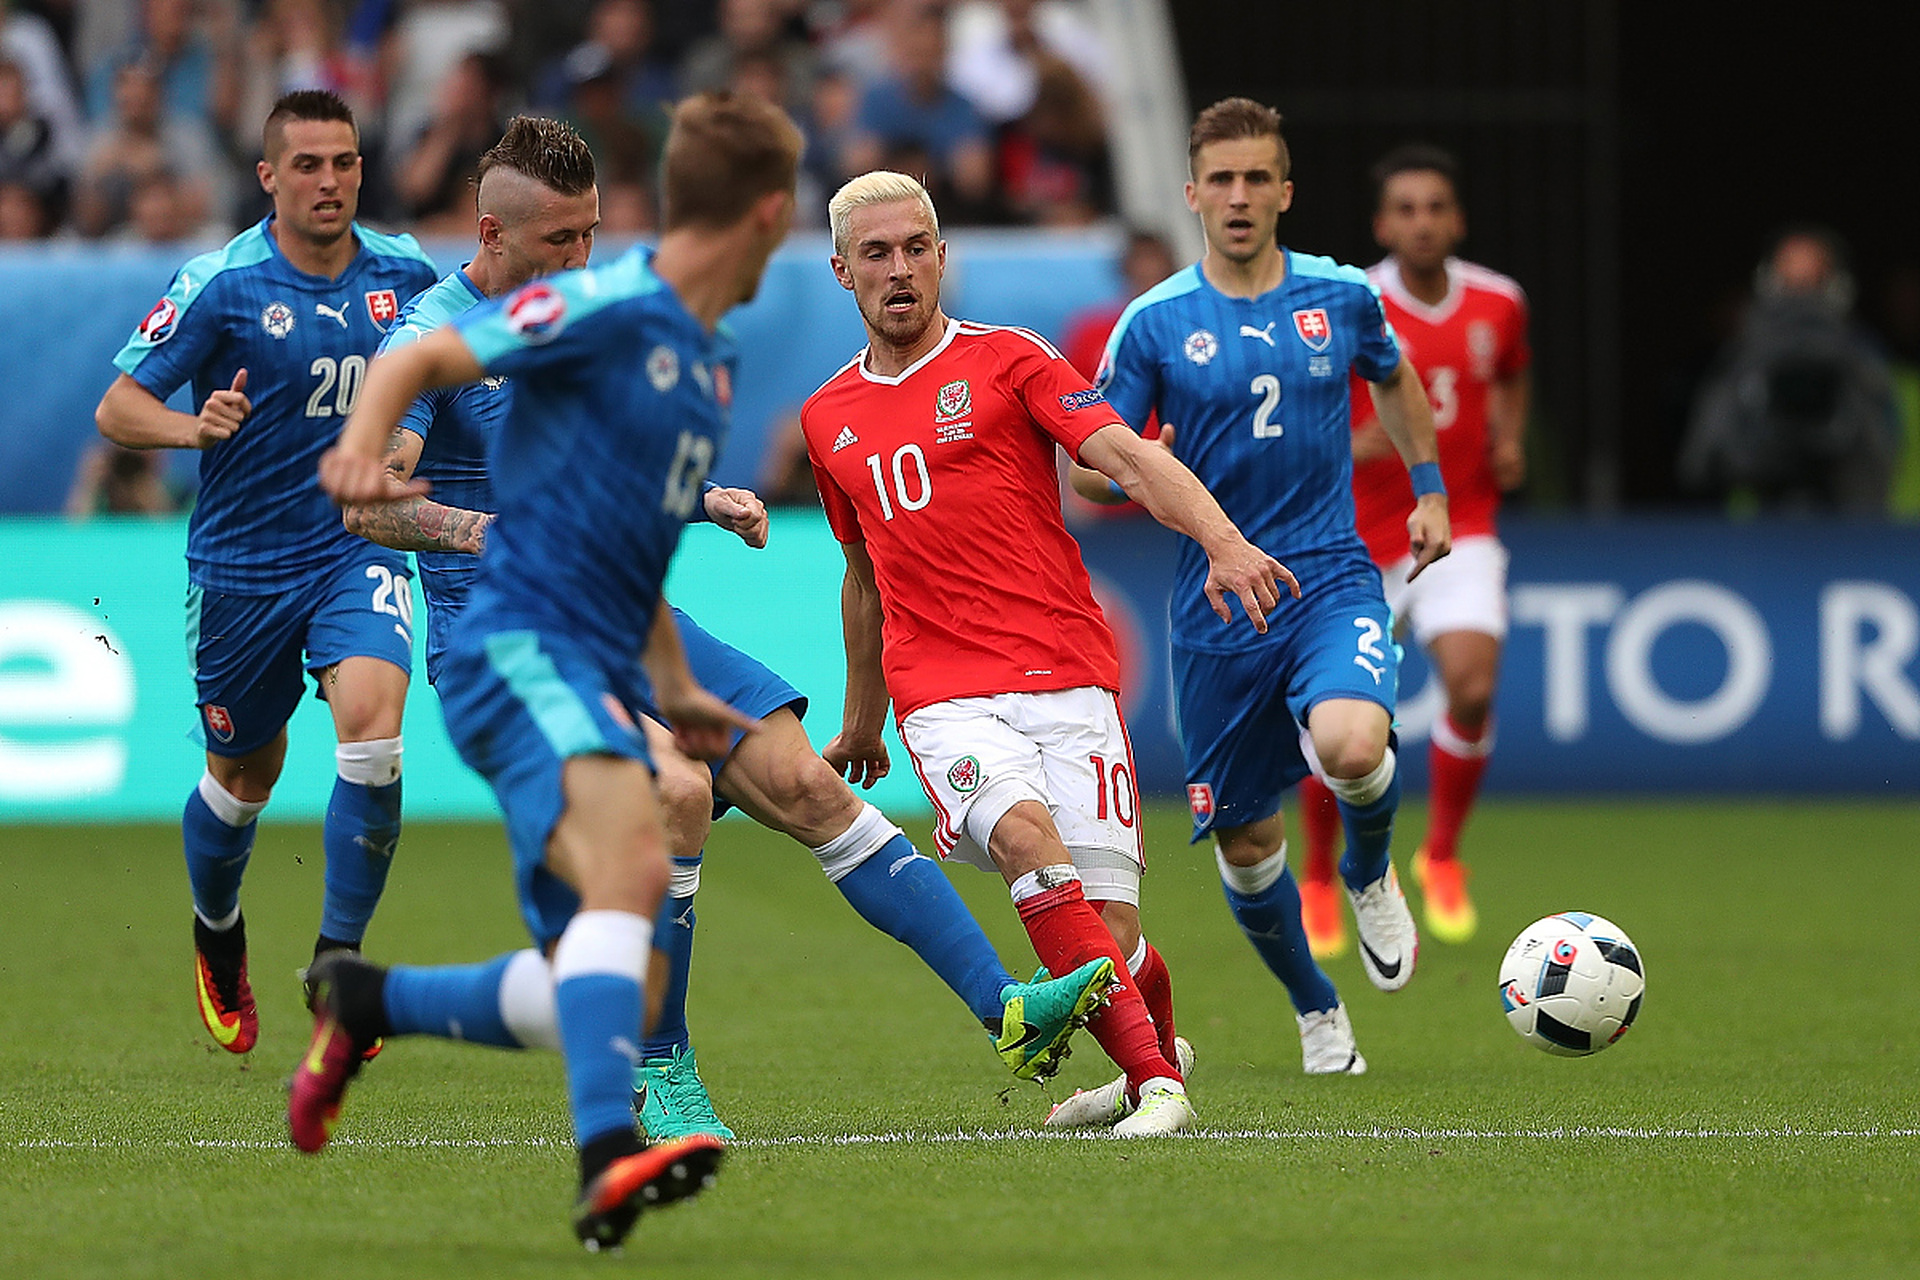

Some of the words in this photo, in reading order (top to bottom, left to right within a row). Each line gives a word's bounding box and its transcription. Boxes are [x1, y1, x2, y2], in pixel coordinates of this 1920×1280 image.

[305, 354, 366, 418] 20
[1251, 374, 1283, 439] 2
[866, 443, 933, 521] 10
[365, 565, 413, 630] 20
[1353, 616, 1385, 660] 2
[1511, 580, 1774, 743] TO
[1090, 755, 1133, 828] 10
